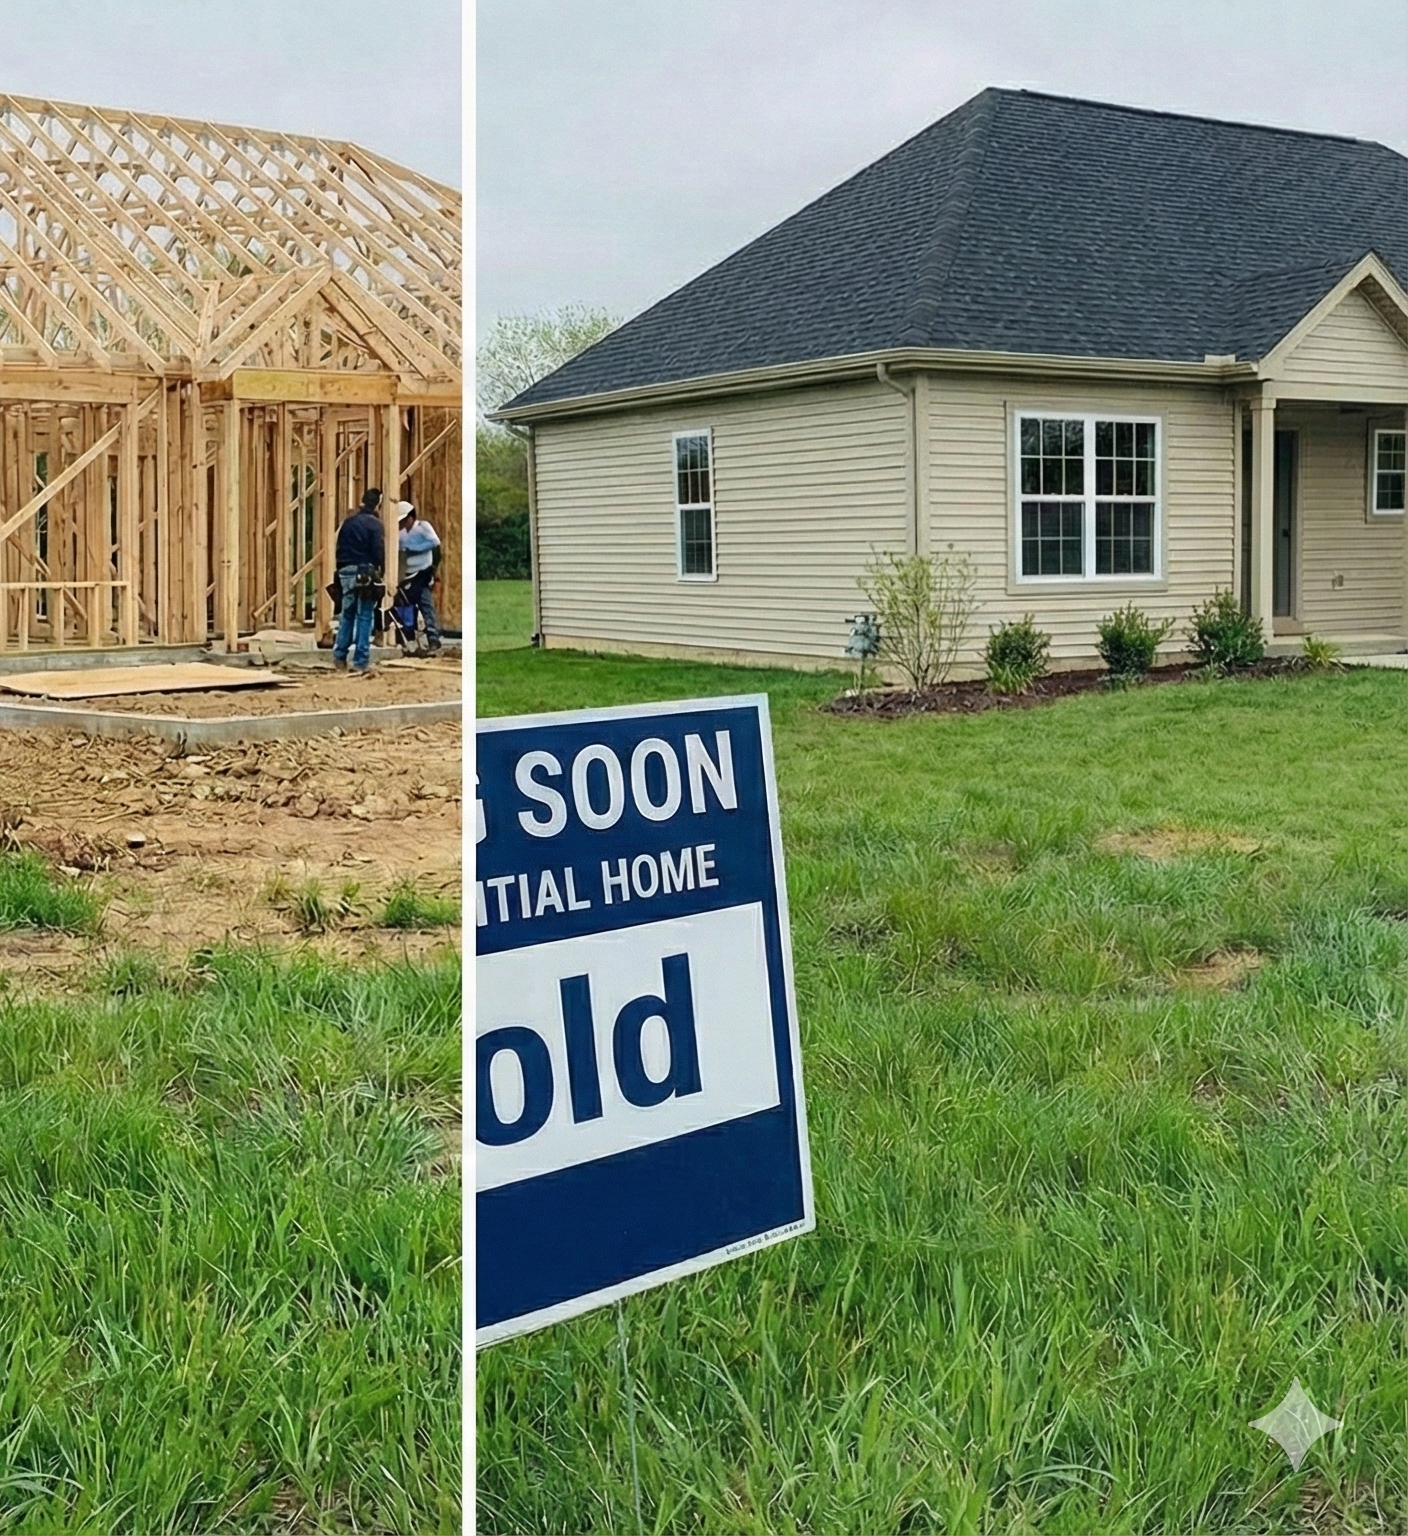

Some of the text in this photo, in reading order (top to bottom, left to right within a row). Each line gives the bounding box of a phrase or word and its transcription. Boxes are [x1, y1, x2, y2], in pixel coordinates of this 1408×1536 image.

[514, 729, 738, 838] SOON
[600, 843, 720, 905] HOME
[476, 952, 703, 1147] old
